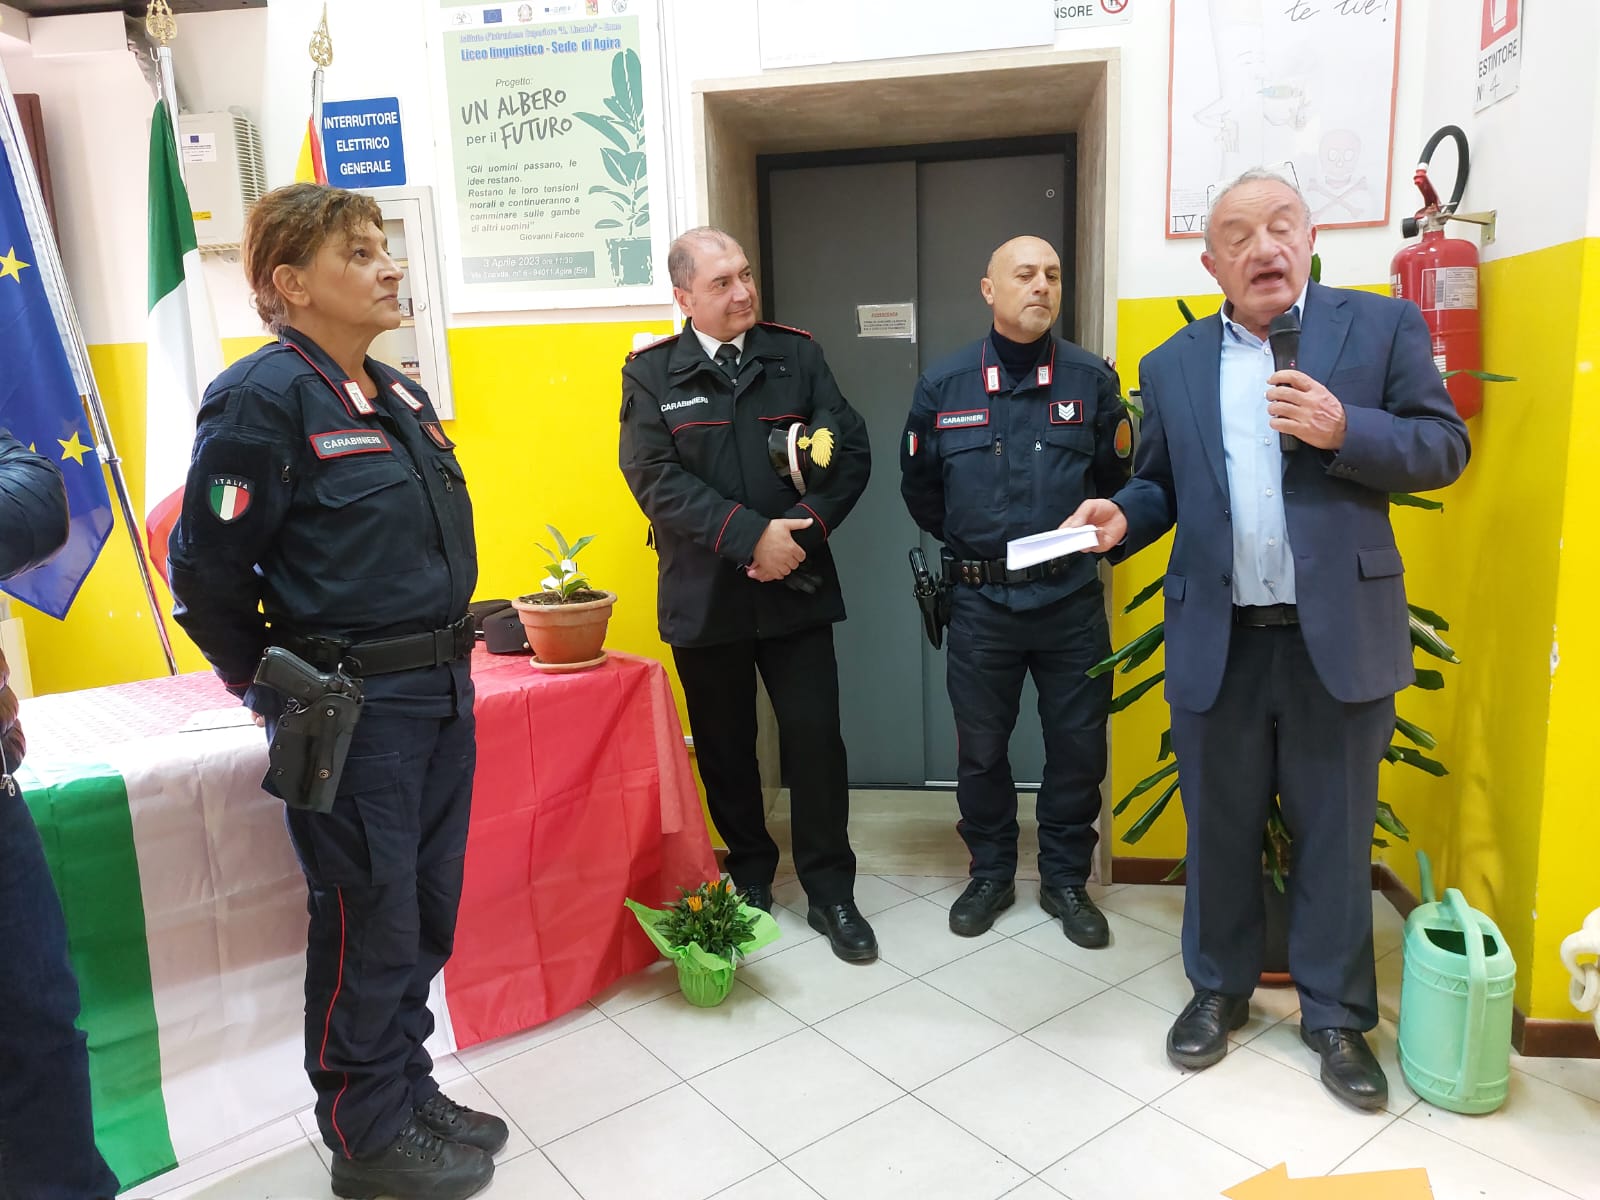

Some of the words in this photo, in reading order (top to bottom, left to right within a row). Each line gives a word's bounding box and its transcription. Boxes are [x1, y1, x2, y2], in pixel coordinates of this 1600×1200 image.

[461, 48, 488, 62] Liceo
[489, 44, 544, 60] linguistico
[551, 41, 577, 54] Sede
[581, 40, 591, 51] di
[593, 37, 621, 51] Agira
[1479, 38, 1518, 78] ESTINTORE
[495, 77, 534, 88] Progetto:
[461, 99, 489, 125] UN
[497, 88, 567, 119] ALBERO
[324, 111, 398, 129] INTERRUTTORE
[466, 134, 487, 146] per
[490, 132, 497, 143] il
[500, 116, 573, 150] FUTURO
[336, 136, 390, 152] ELETTRICO
[340, 160, 392, 175] GENERALE
[488, 163, 518, 172] uomini
[523, 162, 563, 171] passano,
[569, 159, 577, 168] le
[467, 177, 485, 186] idee
[487, 175, 521, 185] restano.
[468, 188, 504, 197] Restano
[508, 187, 517, 195] le
[521, 185, 539, 194] loro
[543, 183, 579, 193] tensioni
[469, 200, 496, 209] morali
[507, 196, 571, 207] continueranno
[470, 210, 518, 221] camminare
[523, 208, 545, 218] sulle
[550, 206, 581, 219] gambe
[471, 224, 479, 232] di
[481, 222, 498, 232] altri
[519, 232, 553, 241] Giovanni
[554, 230, 585, 239] Falcone
[491, 258, 516, 270] Aprile
[518, 257, 540, 266] 2023
[660, 396, 709, 412] CARABINIERI
[942, 414, 983, 424] CARABINIERI
[323, 435, 381, 450] CARABINIERI
[214, 478, 249, 490] ITALIA
